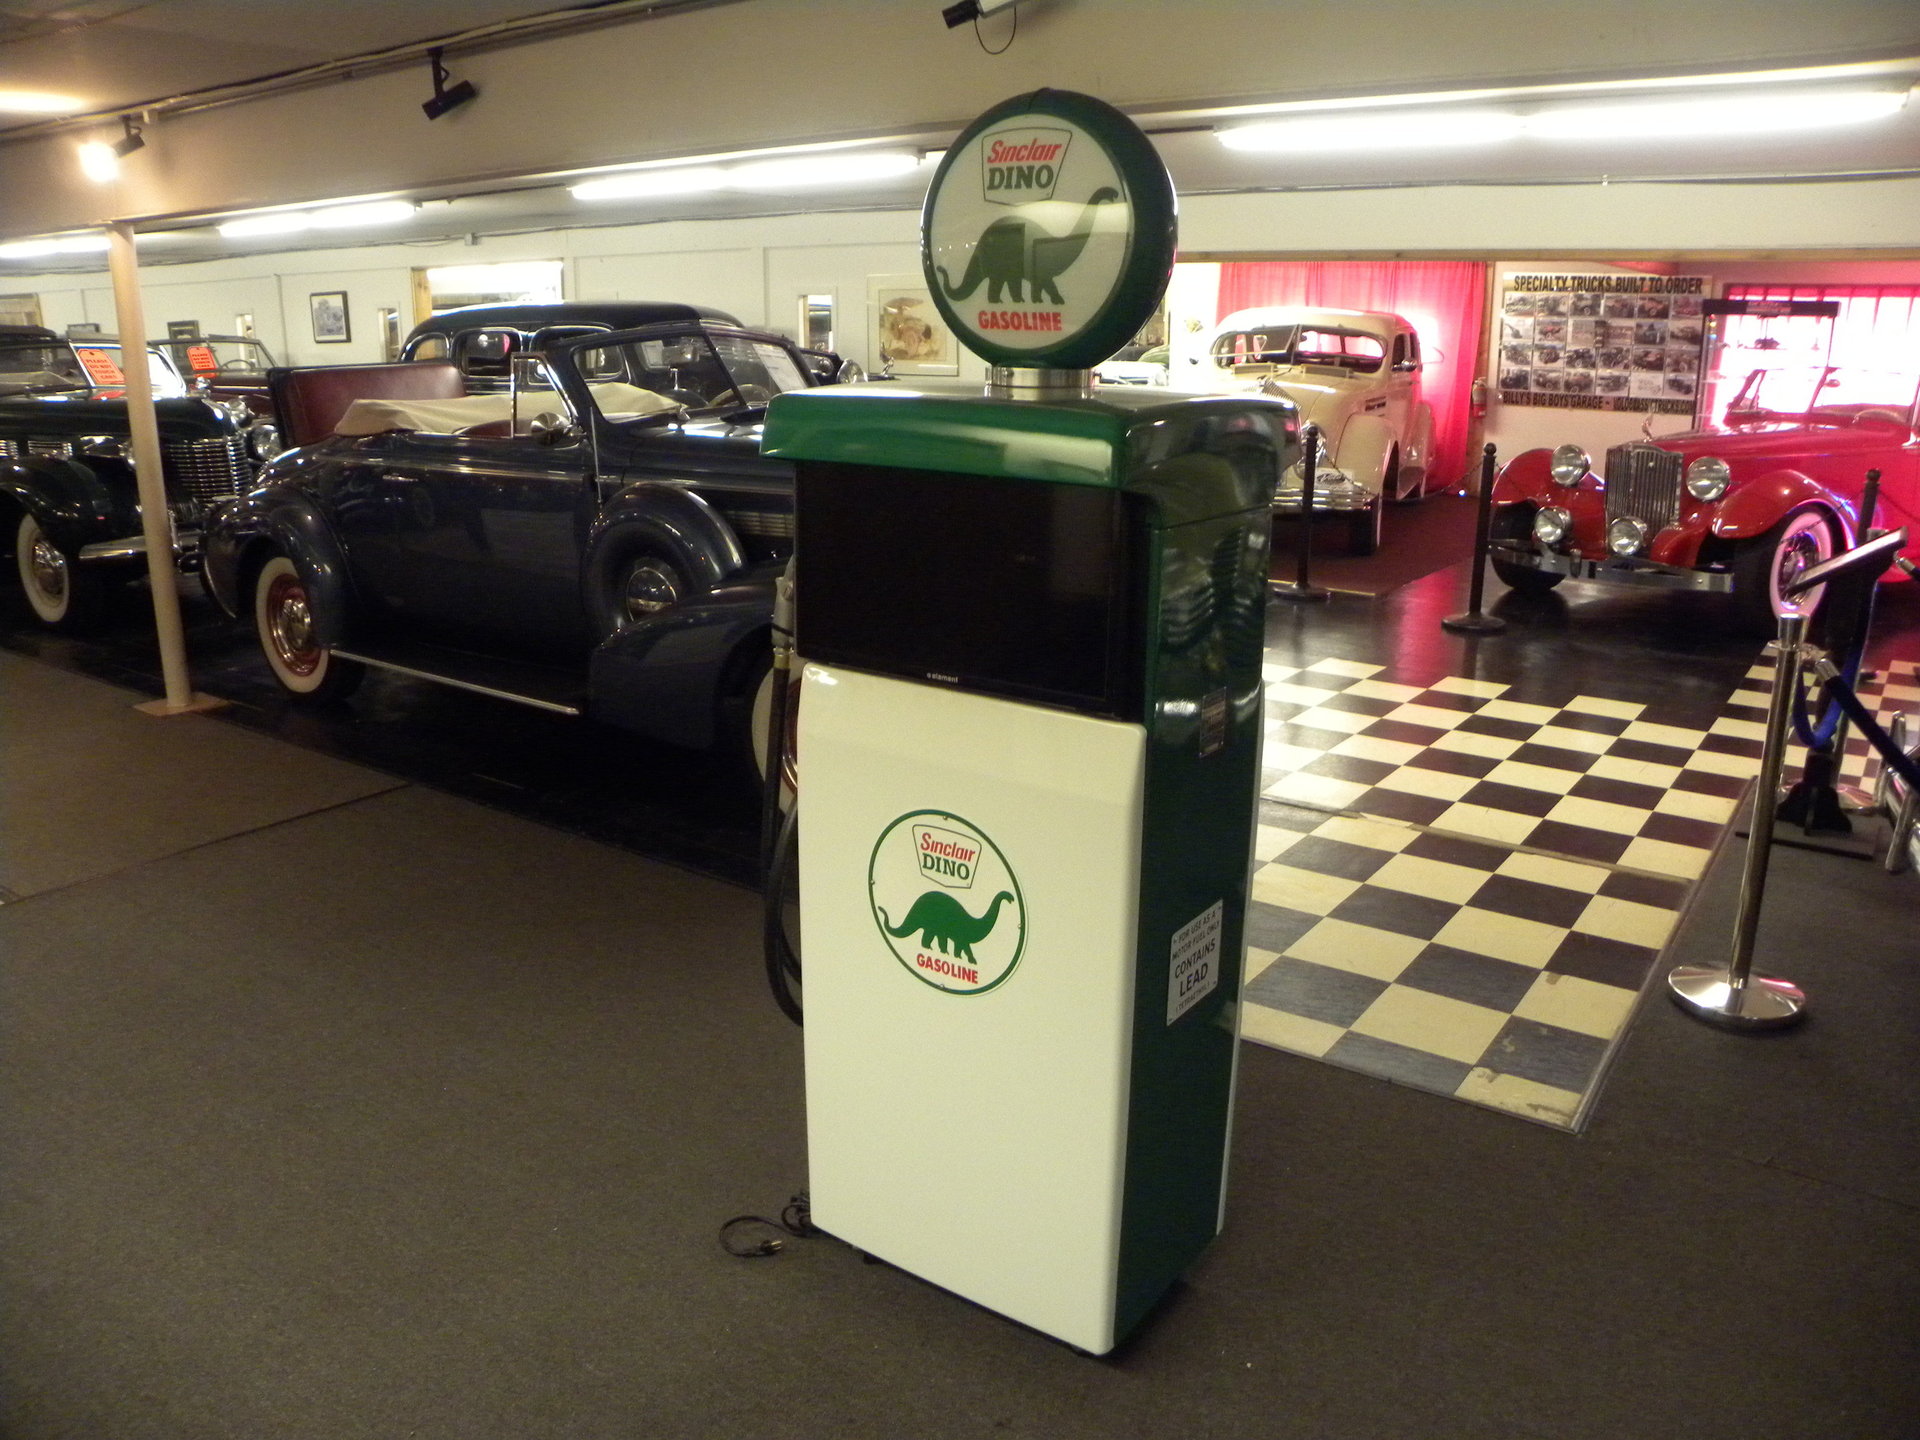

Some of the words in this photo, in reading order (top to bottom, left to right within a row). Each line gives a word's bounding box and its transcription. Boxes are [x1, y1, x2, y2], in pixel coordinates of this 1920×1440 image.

[987, 138, 1062, 164] Sinclair
[986, 164, 1053, 190] DINO
[1514, 275, 1568, 291] SPECIALTY
[1570, 275, 1612, 292] TRUCKS
[1615, 276, 1646, 293] BUILT
[1648, 277, 1662, 293] TO
[1665, 277, 1703, 294] ORDER
[978, 310, 1063, 331] GASOLINE
[1503, 391, 1531, 406] BILLY'S
[1532, 391, 1546, 406] BIG
[1570, 394, 1604, 409] GARAGE
[931, 673, 959, 683] element
[920, 832, 976, 862] Sinclair
[922, 852, 970, 881] DINO
[1172, 940, 1191, 960] MOTOR
[1193, 931, 1206, 946] FUEL
[1207, 920, 1220, 936] ONLY
[1178, 928, 1190, 943] FOR
[1191, 920, 1201, 934] USE
[1203, 913, 1211, 925] AS
[1212, 910, 1217, 919] A
[916, 953, 978, 984] GASOLINE
[1175, 938, 1216, 979] CONTAINS
[1180, 962, 1208, 997] LEAD
